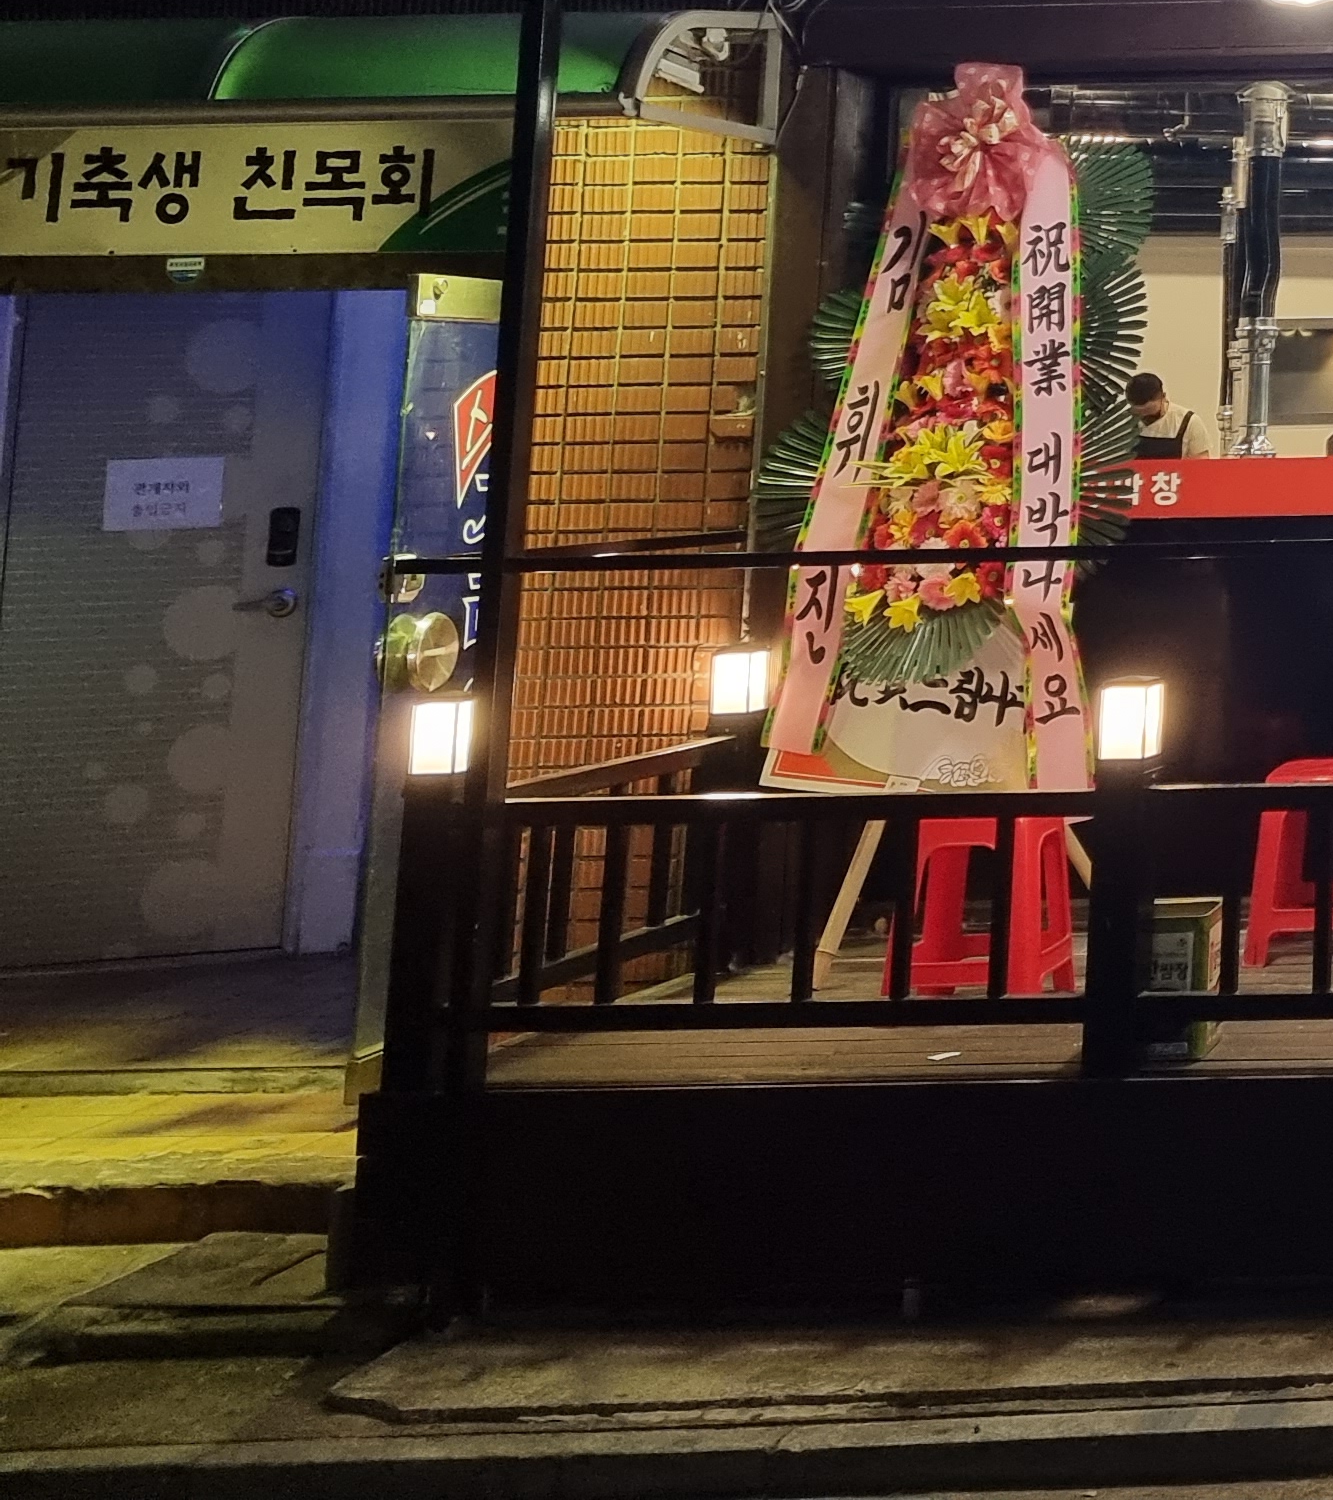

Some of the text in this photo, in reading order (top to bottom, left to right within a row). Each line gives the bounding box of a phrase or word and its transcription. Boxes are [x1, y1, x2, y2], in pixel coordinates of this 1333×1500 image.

[232, 145, 436, 223] 친목회
[1021, 220, 1072, 398] 祝開業
